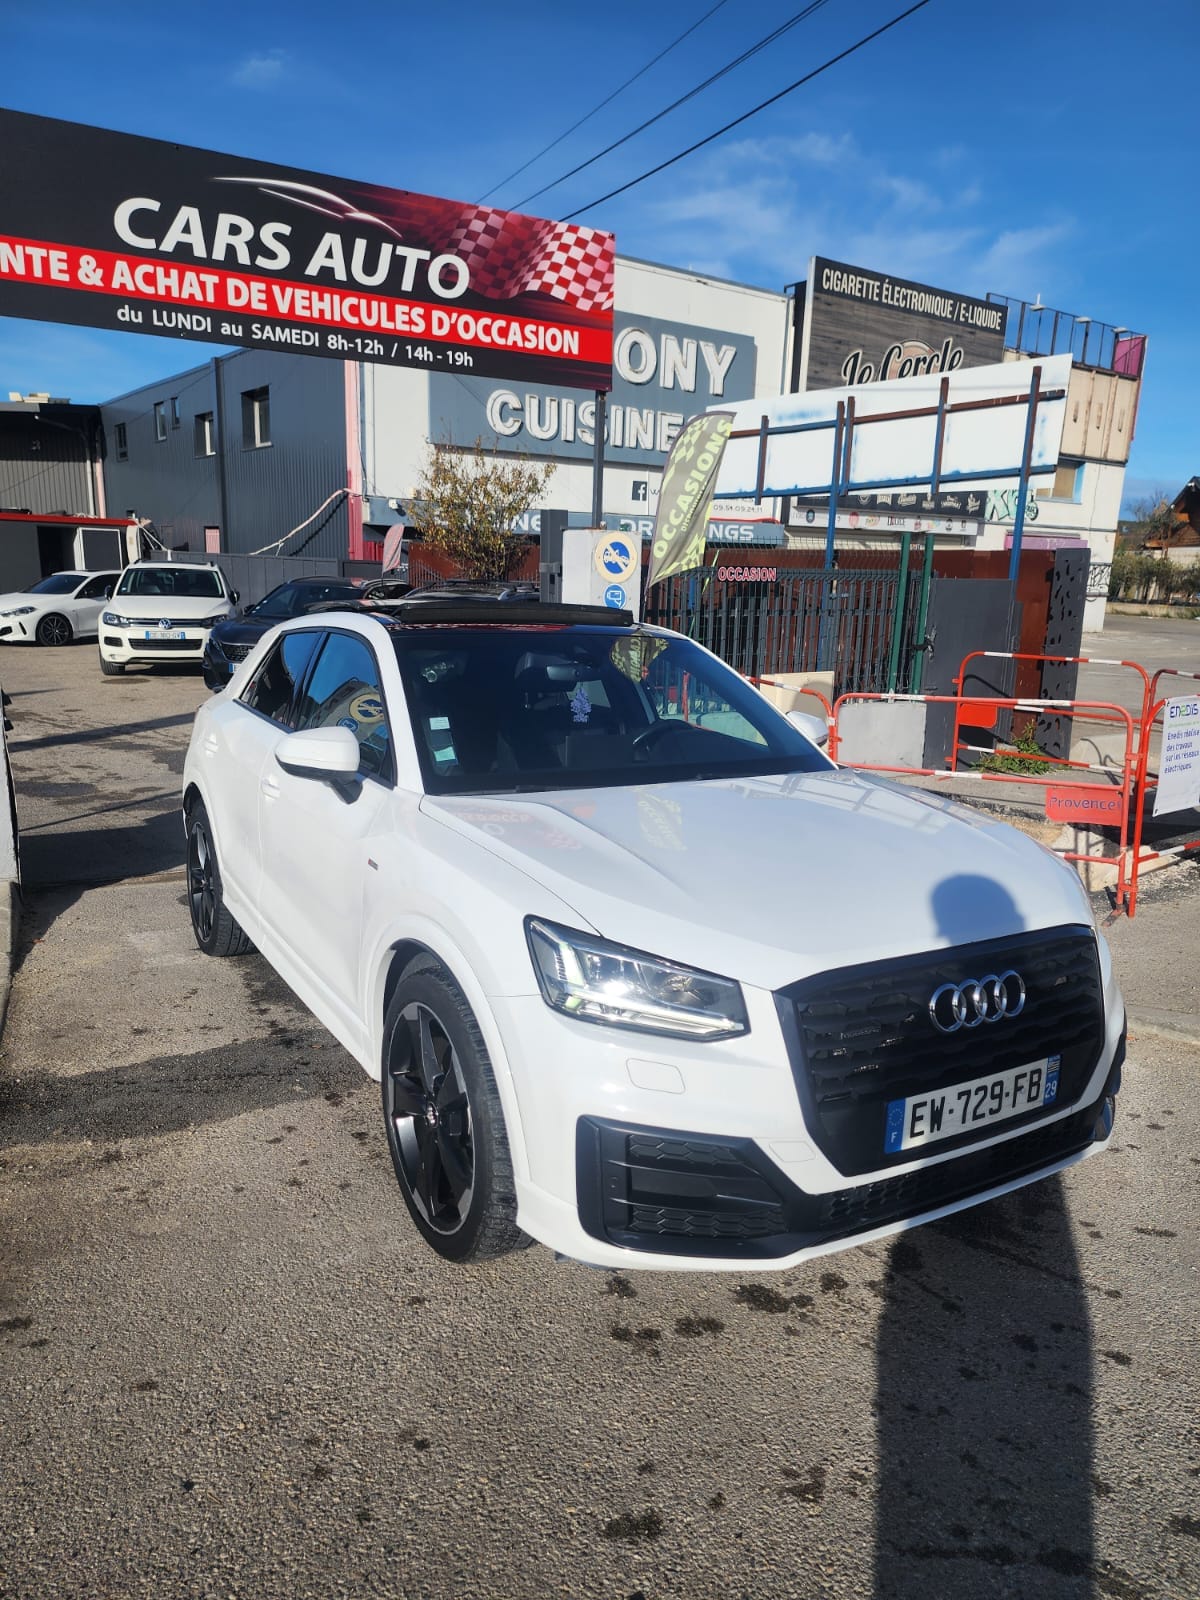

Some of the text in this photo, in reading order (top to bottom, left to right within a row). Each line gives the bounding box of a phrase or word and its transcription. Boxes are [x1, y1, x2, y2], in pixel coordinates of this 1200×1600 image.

[113, 197, 471, 299] CARS AUTO
[77, 254, 104, 287] &
[111, 260, 221, 304] ACHAT
[227, 278, 268, 311] DE
[272, 286, 426, 334] VEHICULES
[431, 307, 580, 356] D’OCCASION
[822, 268, 1002, 331] CIGARETTE ÉLECTRONIQUE / E-LIQUIDE
[117, 304, 143, 324] du
[152, 309, 212, 333] LUNDI
[221, 322, 243, 337] au
[252, 324, 319, 347] SAMEDI
[327, 333, 384, 357] 8h-12h
[391, 342, 398, 359] /
[877, 338, 964, 383] Cercle
[486, 390, 697, 452] CUISINE
[653, 419, 734, 559] OCCASIONS
[717, 566, 777, 582] OCCASION
[1175, 741, 1193, 751] travaux
[890, 1068, 1042, 1143] F EW-729-FB
[1045, 1080, 1058, 1098] 29
